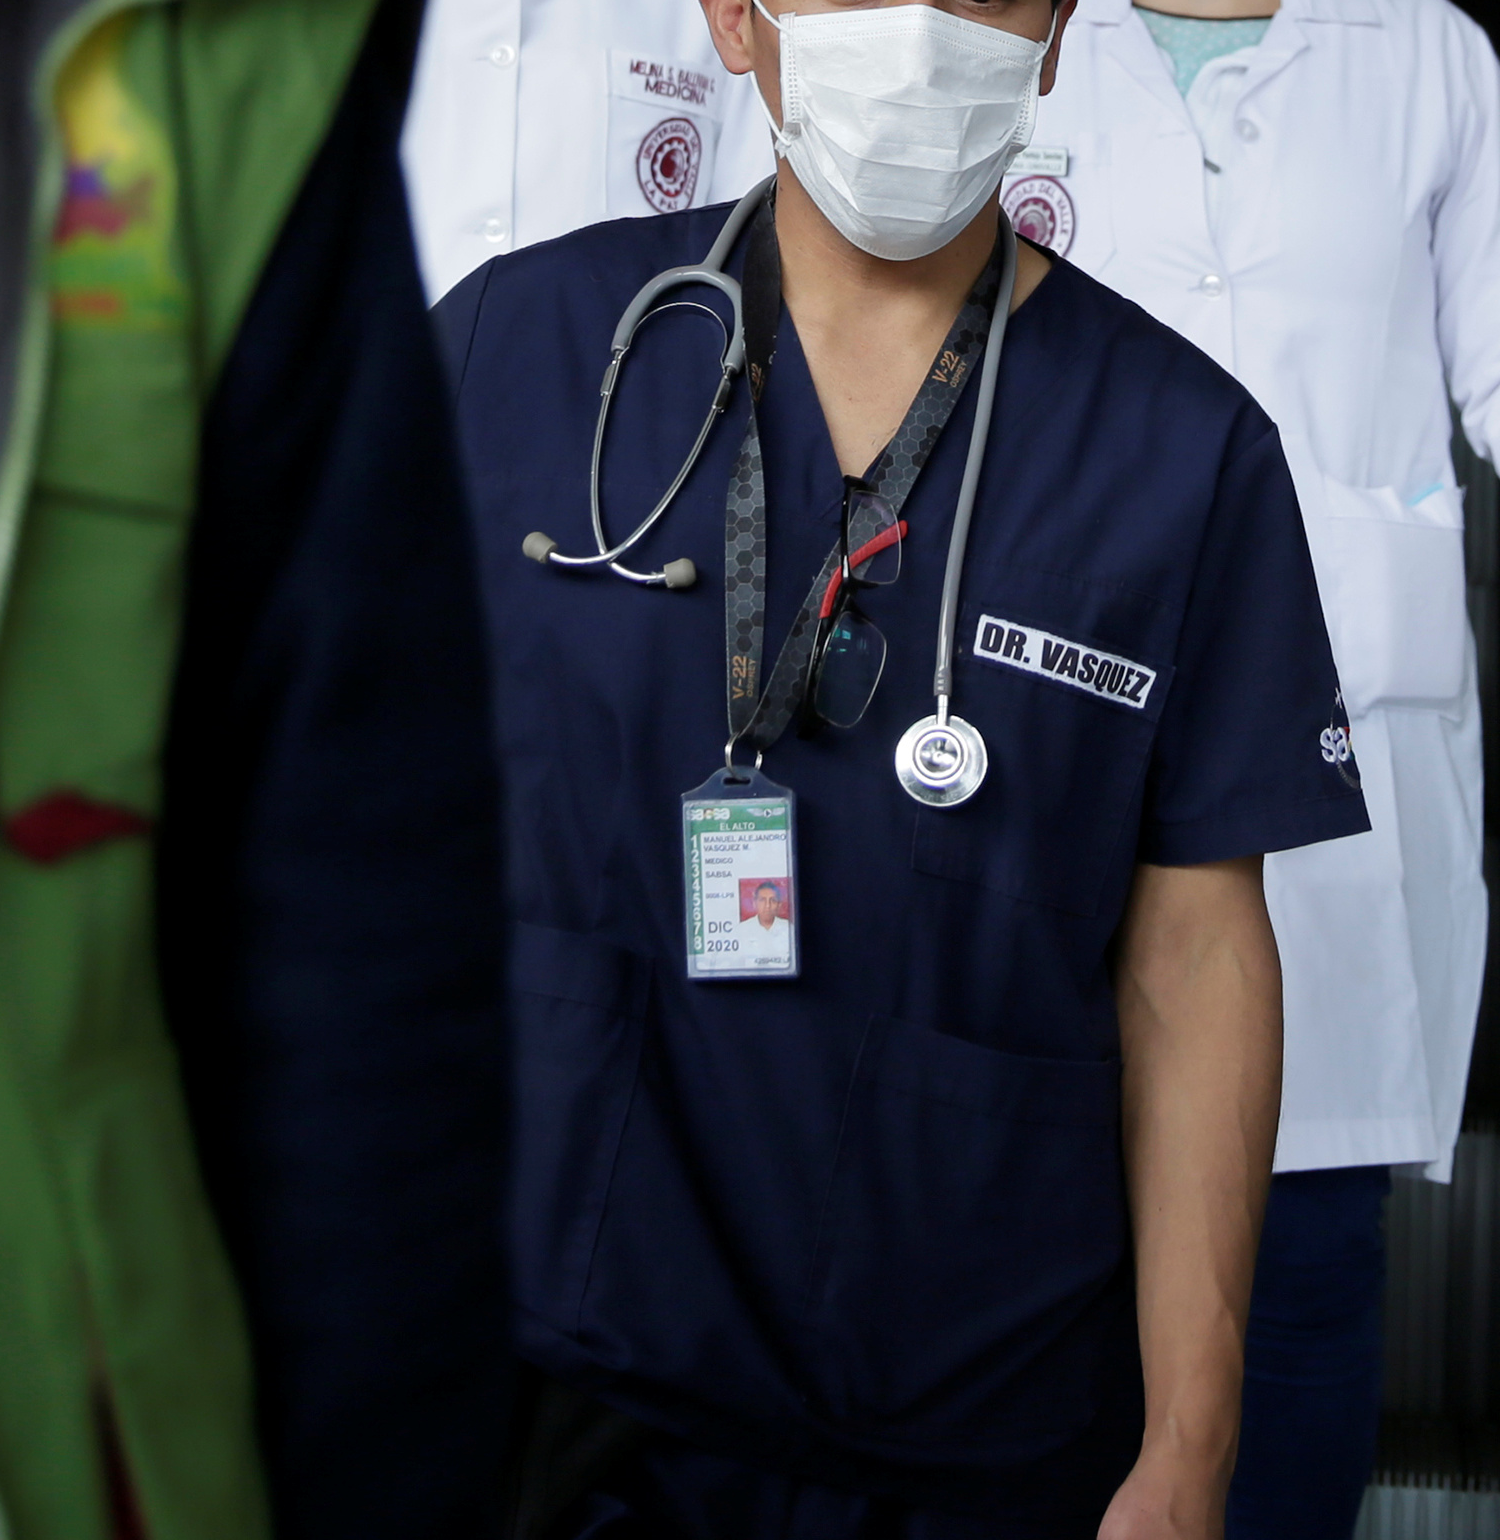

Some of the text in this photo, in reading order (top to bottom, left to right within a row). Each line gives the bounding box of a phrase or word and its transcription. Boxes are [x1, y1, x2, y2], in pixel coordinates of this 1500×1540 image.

[645, 79, 706, 106] MEDICINA
[931, 350, 959, 383] V-22
[980, 622, 1151, 703] DR. VASQUEZ
[732, 655, 746, 699] V-22
[719, 822, 756, 831] EL ALTO
[690, 834, 698, 849] 1
[704, 833, 787, 843] MANUEL ALEJANDRO
[704, 844, 740, 852] VASQUEZ
[691, 850, 700, 863] 2
[692, 864, 700, 878] 3
[705, 871, 732, 879] SABSA
[692, 878, 700, 891] 4
[693, 892, 701, 907] 5
[693, 907, 701, 921] 6
[694, 922, 701, 935] 7
[708, 921, 733, 933] DIC
[694, 935, 702, 950] 8
[707, 940, 739, 952] 2020
